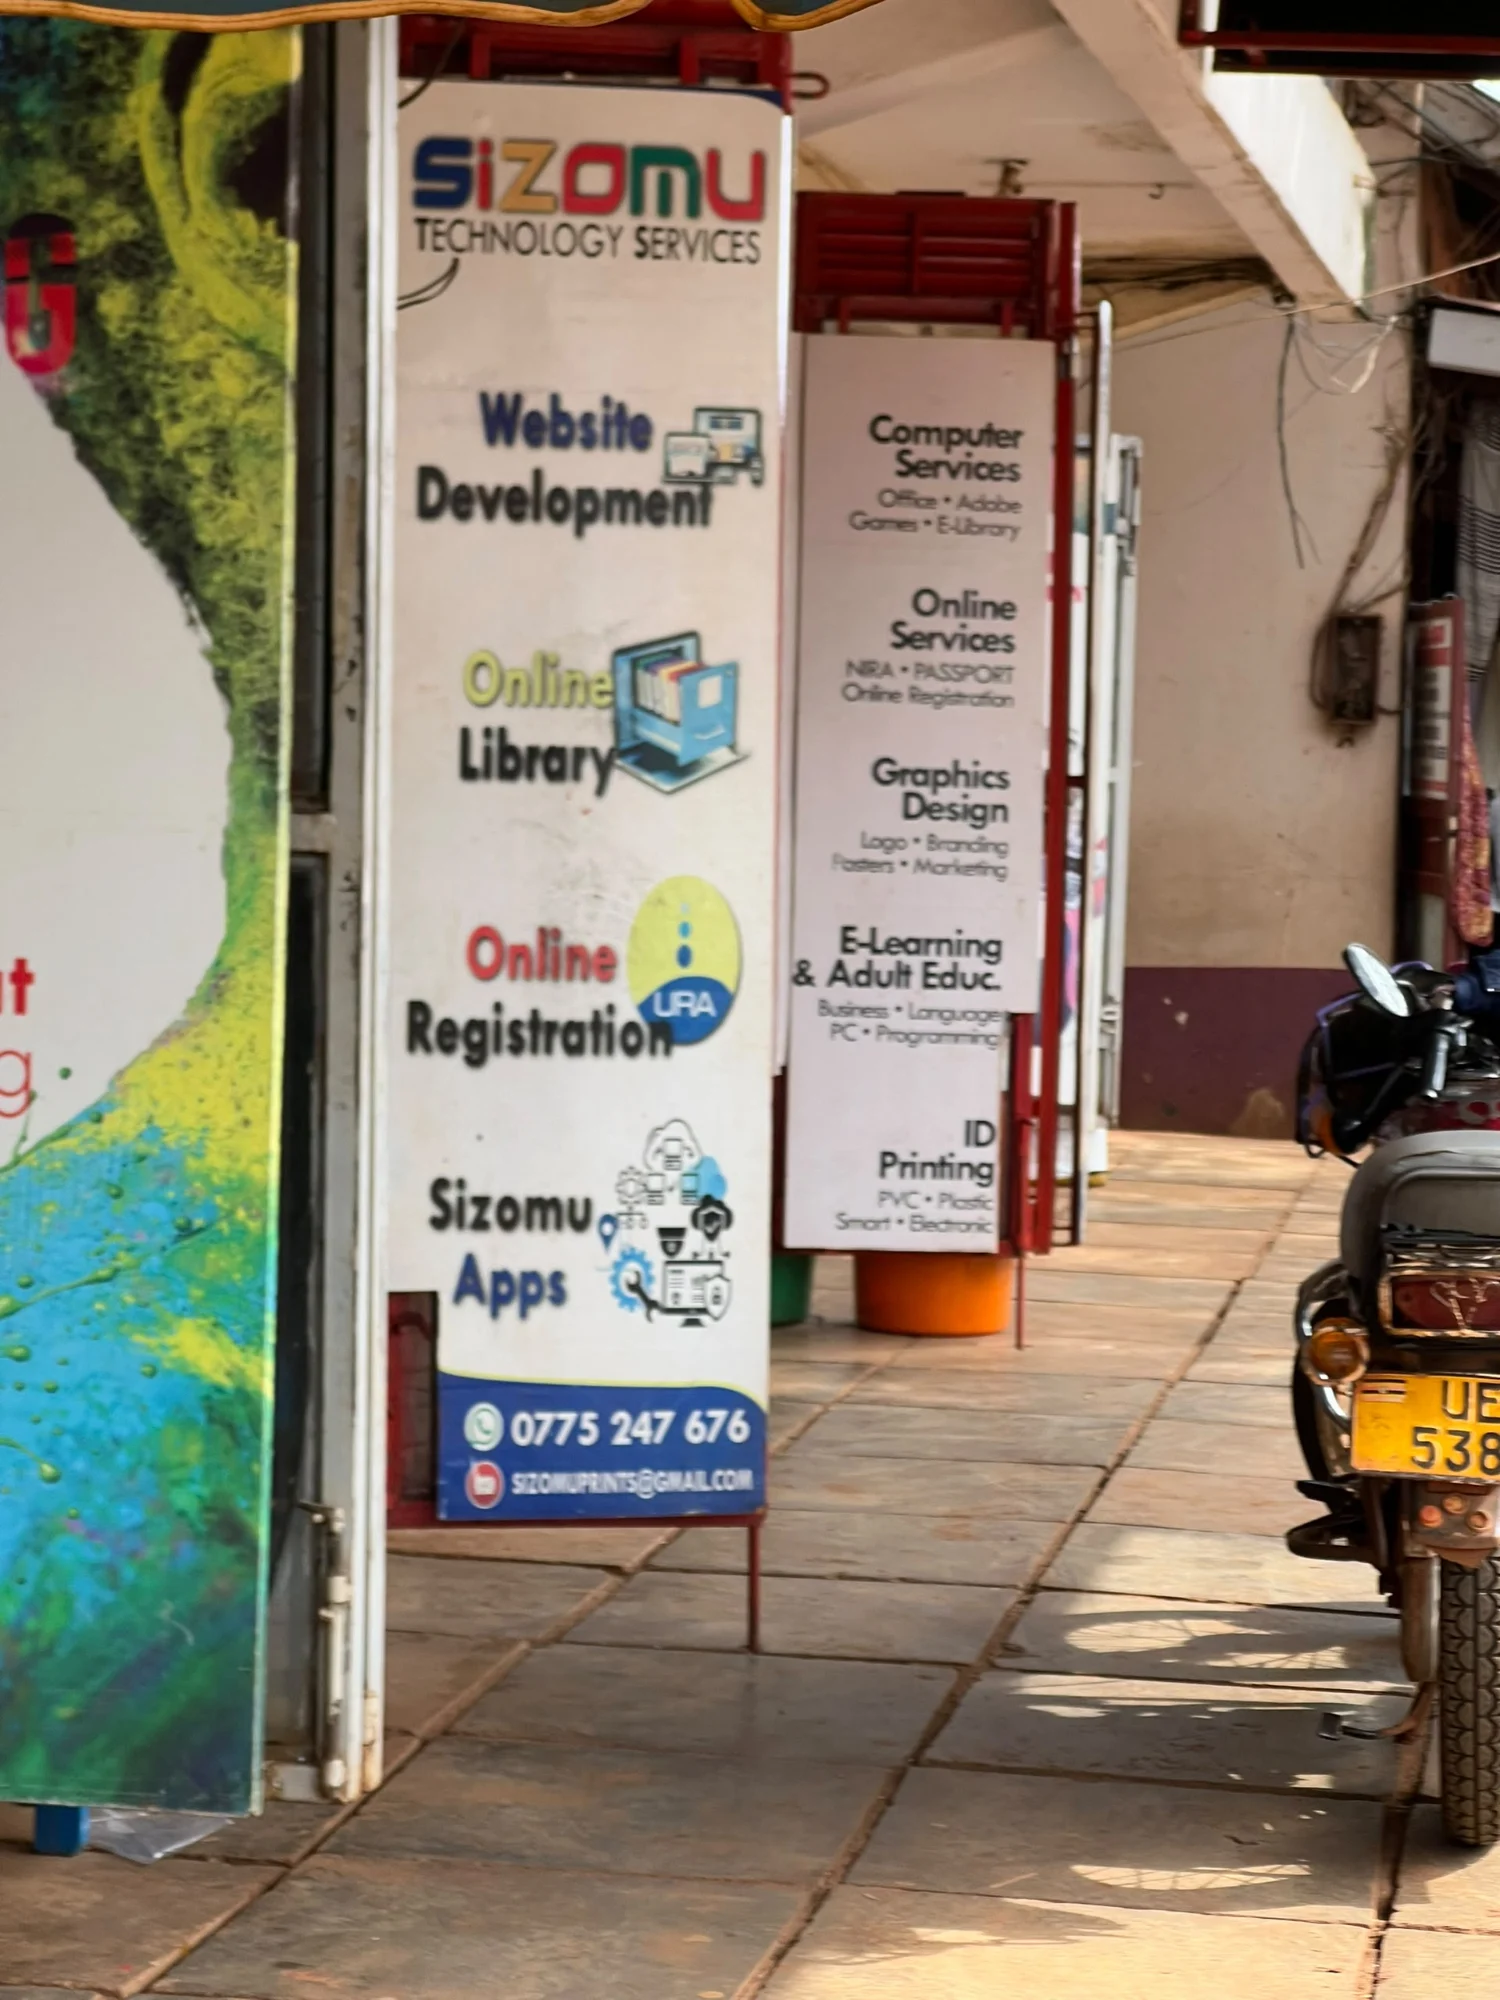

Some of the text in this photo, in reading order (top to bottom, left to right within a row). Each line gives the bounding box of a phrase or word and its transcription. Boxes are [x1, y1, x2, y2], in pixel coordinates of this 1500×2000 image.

[414, 218, 762, 265] TECHNOLOGY SERVICES
[479, 391, 653, 452] Website
[869, 414, 1024, 453] Computer
[895, 449, 1021, 482] Services
[416, 465, 714, 538] Development
[878, 487, 1023, 514] Office Adobe
[849, 510, 1022, 542] Games E-Library
[911, 587, 1018, 620] Online
[890, 620, 1016, 654] Services
[463, 650, 615, 708] Online
[913, 661, 1016, 685] PASSPORT
[842, 682, 1016, 710] Online Registration
[459, 727, 618, 797] Library
[872, 757, 1010, 795] Graphics
[903, 792, 1009, 829] Design
[860, 831, 1009, 859] Logo Branding
[912, 857, 1008, 883] Marketing
[466, 925, 618, 983] Online
[841, 925, 1002, 965] E-Learning
[792, 959, 1002, 991] & Adult Educ.
[653, 991, 716, 1018] URA
[817, 999, 889, 1019] Business
[407, 999, 672, 1068] Registration
[830, 1023, 1000, 1051] PC Programming
[964, 1120, 996, 1148] ID
[879, 1151, 994, 1188] Printing
[429, 1177, 594, 1233] Sizomu
[878, 1190, 993, 1212] PVC Plastic
[836, 1212, 993, 1234] Smart Electronic
[453, 1252, 568, 1320] Apps
[510, 1408, 751, 1447] 0775 247 676
[511, 1469, 755, 1500] SIZOMUPRINTS@GMAIL.COM
